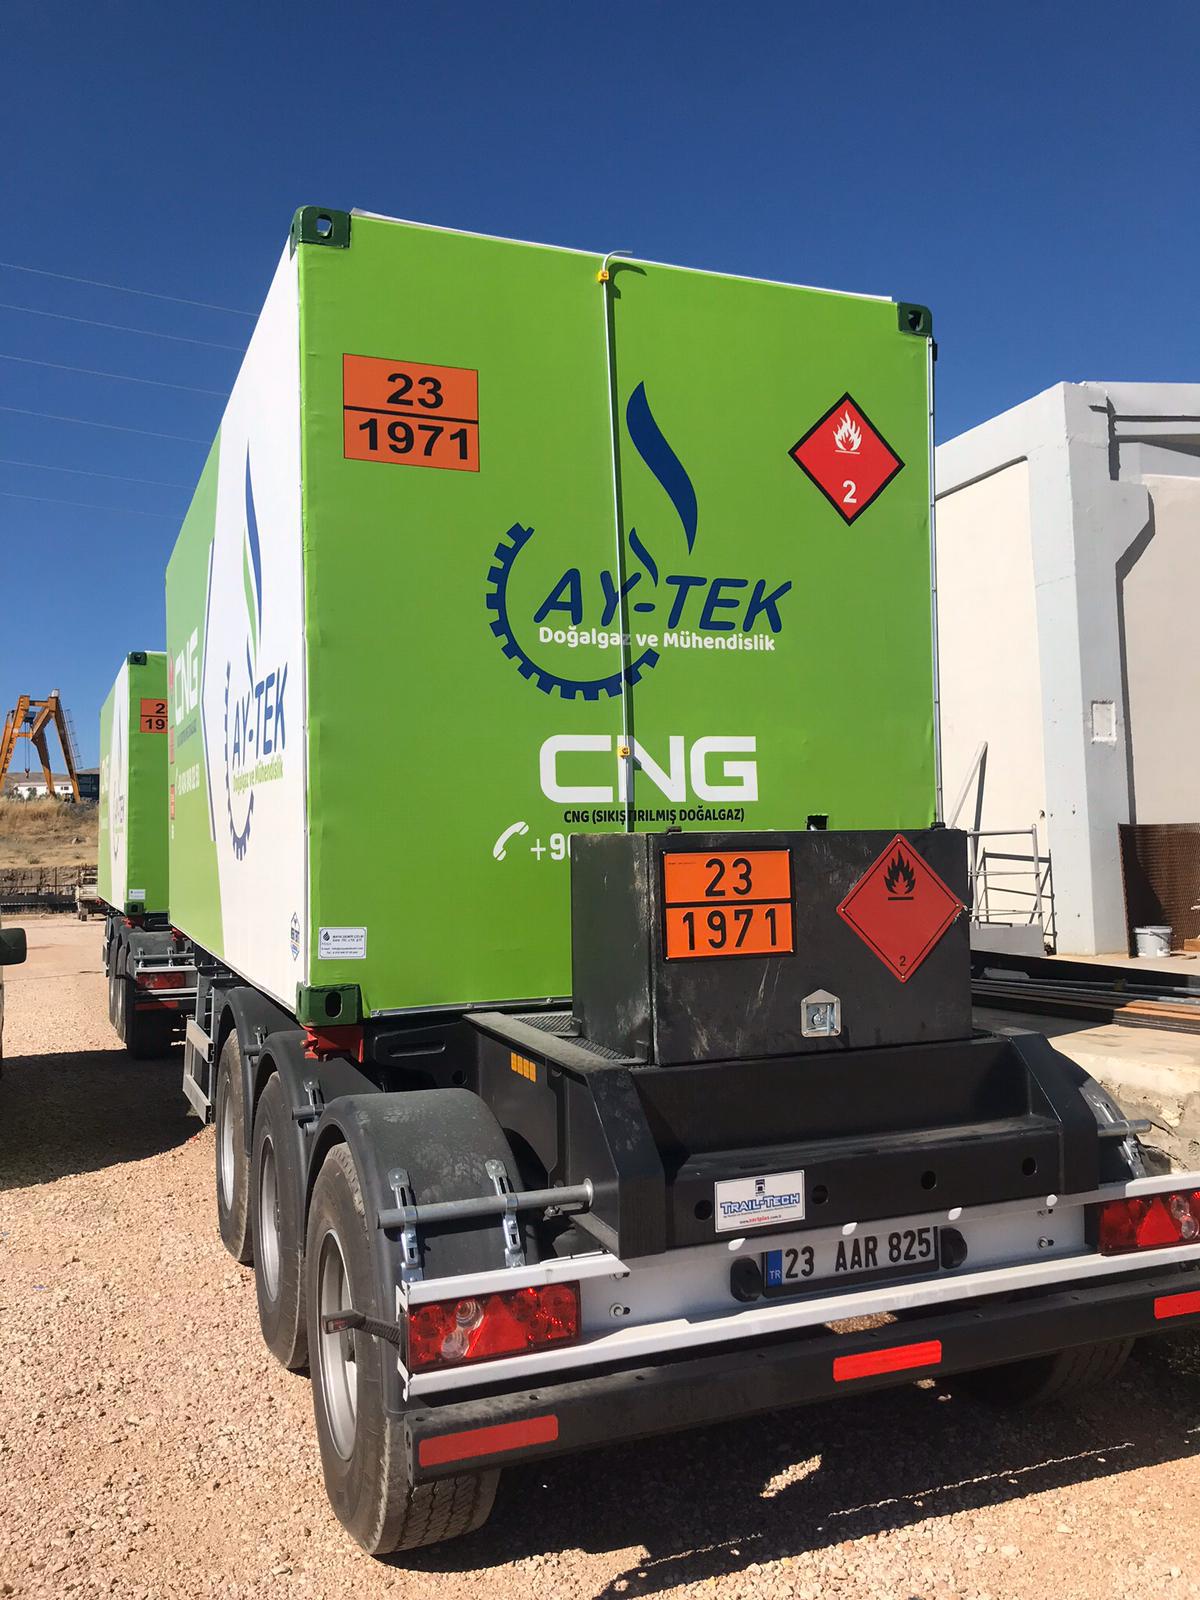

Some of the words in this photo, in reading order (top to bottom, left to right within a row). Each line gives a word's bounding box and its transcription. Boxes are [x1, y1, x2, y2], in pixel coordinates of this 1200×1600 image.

[387, 373, 444, 409] 23
[359, 418, 468, 460] 1971
[842, 480, 857, 504] 2
[533, 568, 792, 633] AY-TEK
[539, 626, 632, 648] Doğalgaz
[635, 633, 659, 646] ve
[663, 631, 776, 651] Mühendislik
[175, 626, 199, 726] CNG
[145, 718, 168, 730] 19
[155, 703, 168, 714] 2
[232, 661, 288, 770] AY-TEK
[539, 734, 759, 803] CNG
[563, 811, 590, 823] CNG
[591, 809, 676, 825] (SIKIŞTIRILMIŞ
[679, 806, 745, 822] DOĞALGAZ)
[530, 833, 571, 861] +9
[705, 857, 752, 897] 23
[682, 908, 777, 951] 1971
[899, 956, 906, 967] 2
[720, 1193, 800, 1215] TRAIL-TECH
[769, 1270, 781, 1280] TR
[785, 1246, 815, 1279] 23
[835, 1236, 878, 1272] AAR
[888, 1227, 931, 1263] 825
